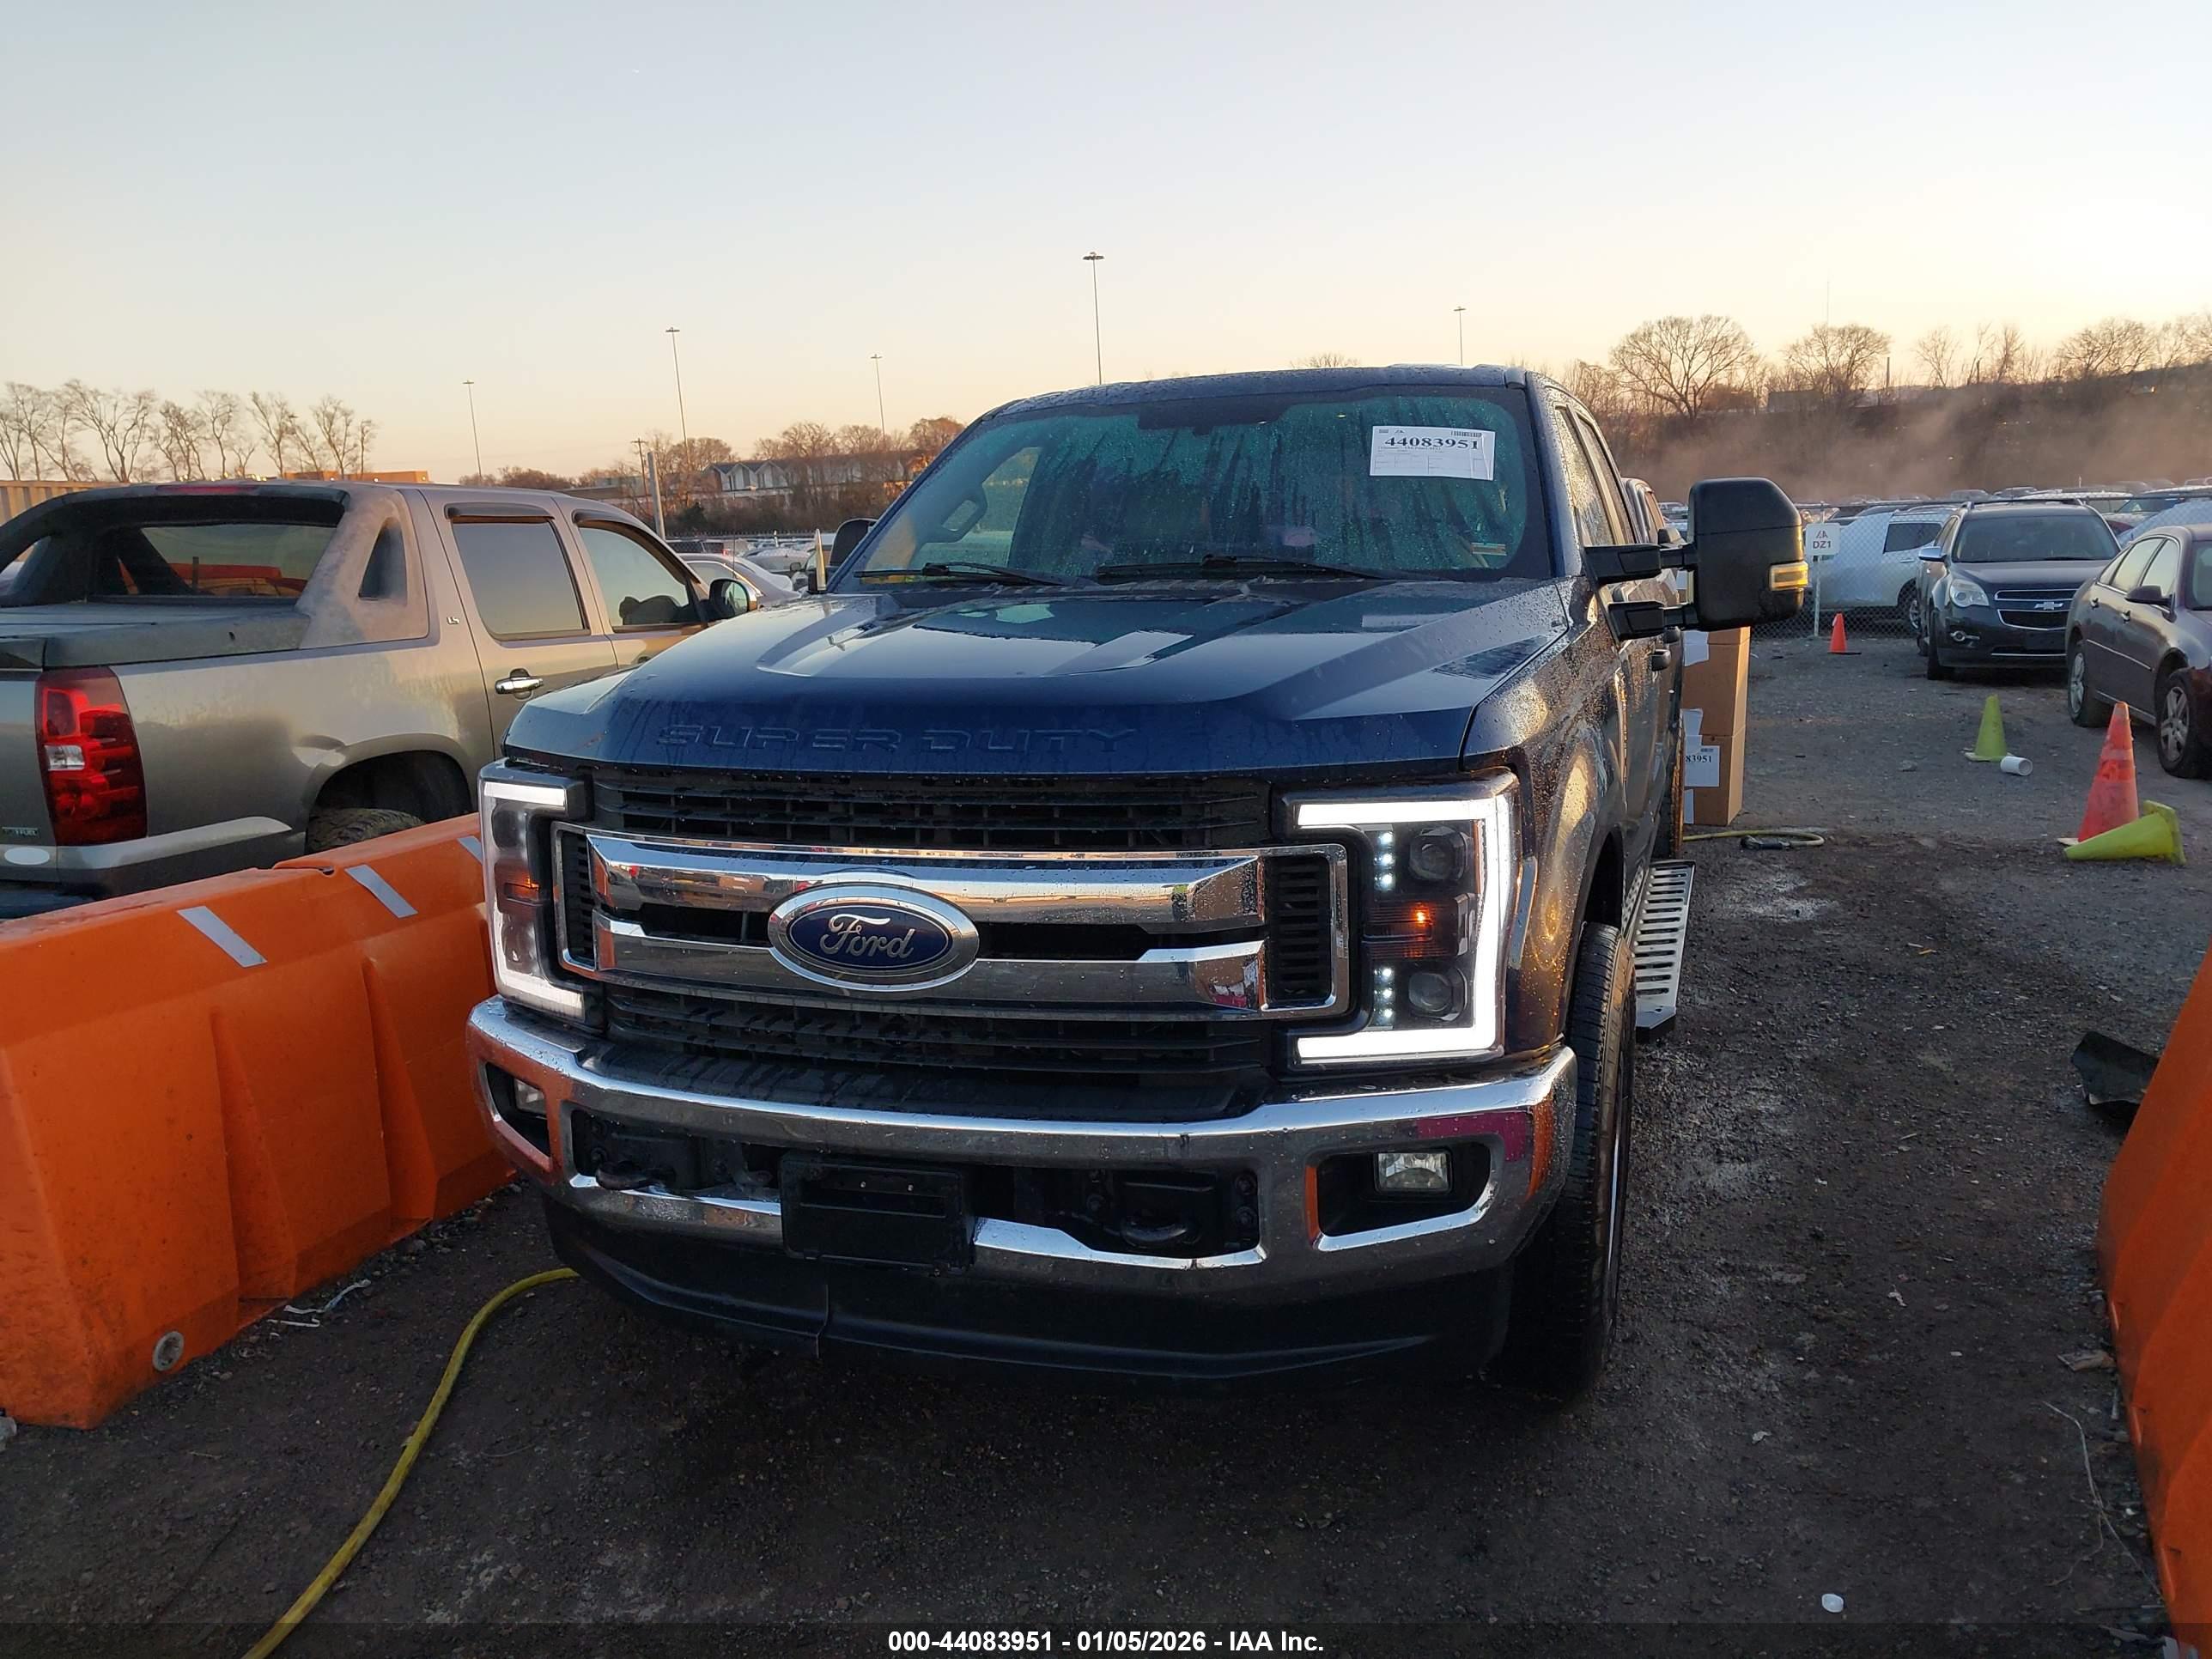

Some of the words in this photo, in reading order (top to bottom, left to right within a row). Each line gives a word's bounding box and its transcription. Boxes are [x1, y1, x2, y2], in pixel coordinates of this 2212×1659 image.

[1384, 436, 1479, 450] 44083951
[1813, 540, 1832, 549] DZ1
[447, 617, 460, 625] LS
[656, 723, 902, 750] SUPER
[921, 728, 1138, 752] DUTY
[819, 913, 916, 958] Ford
